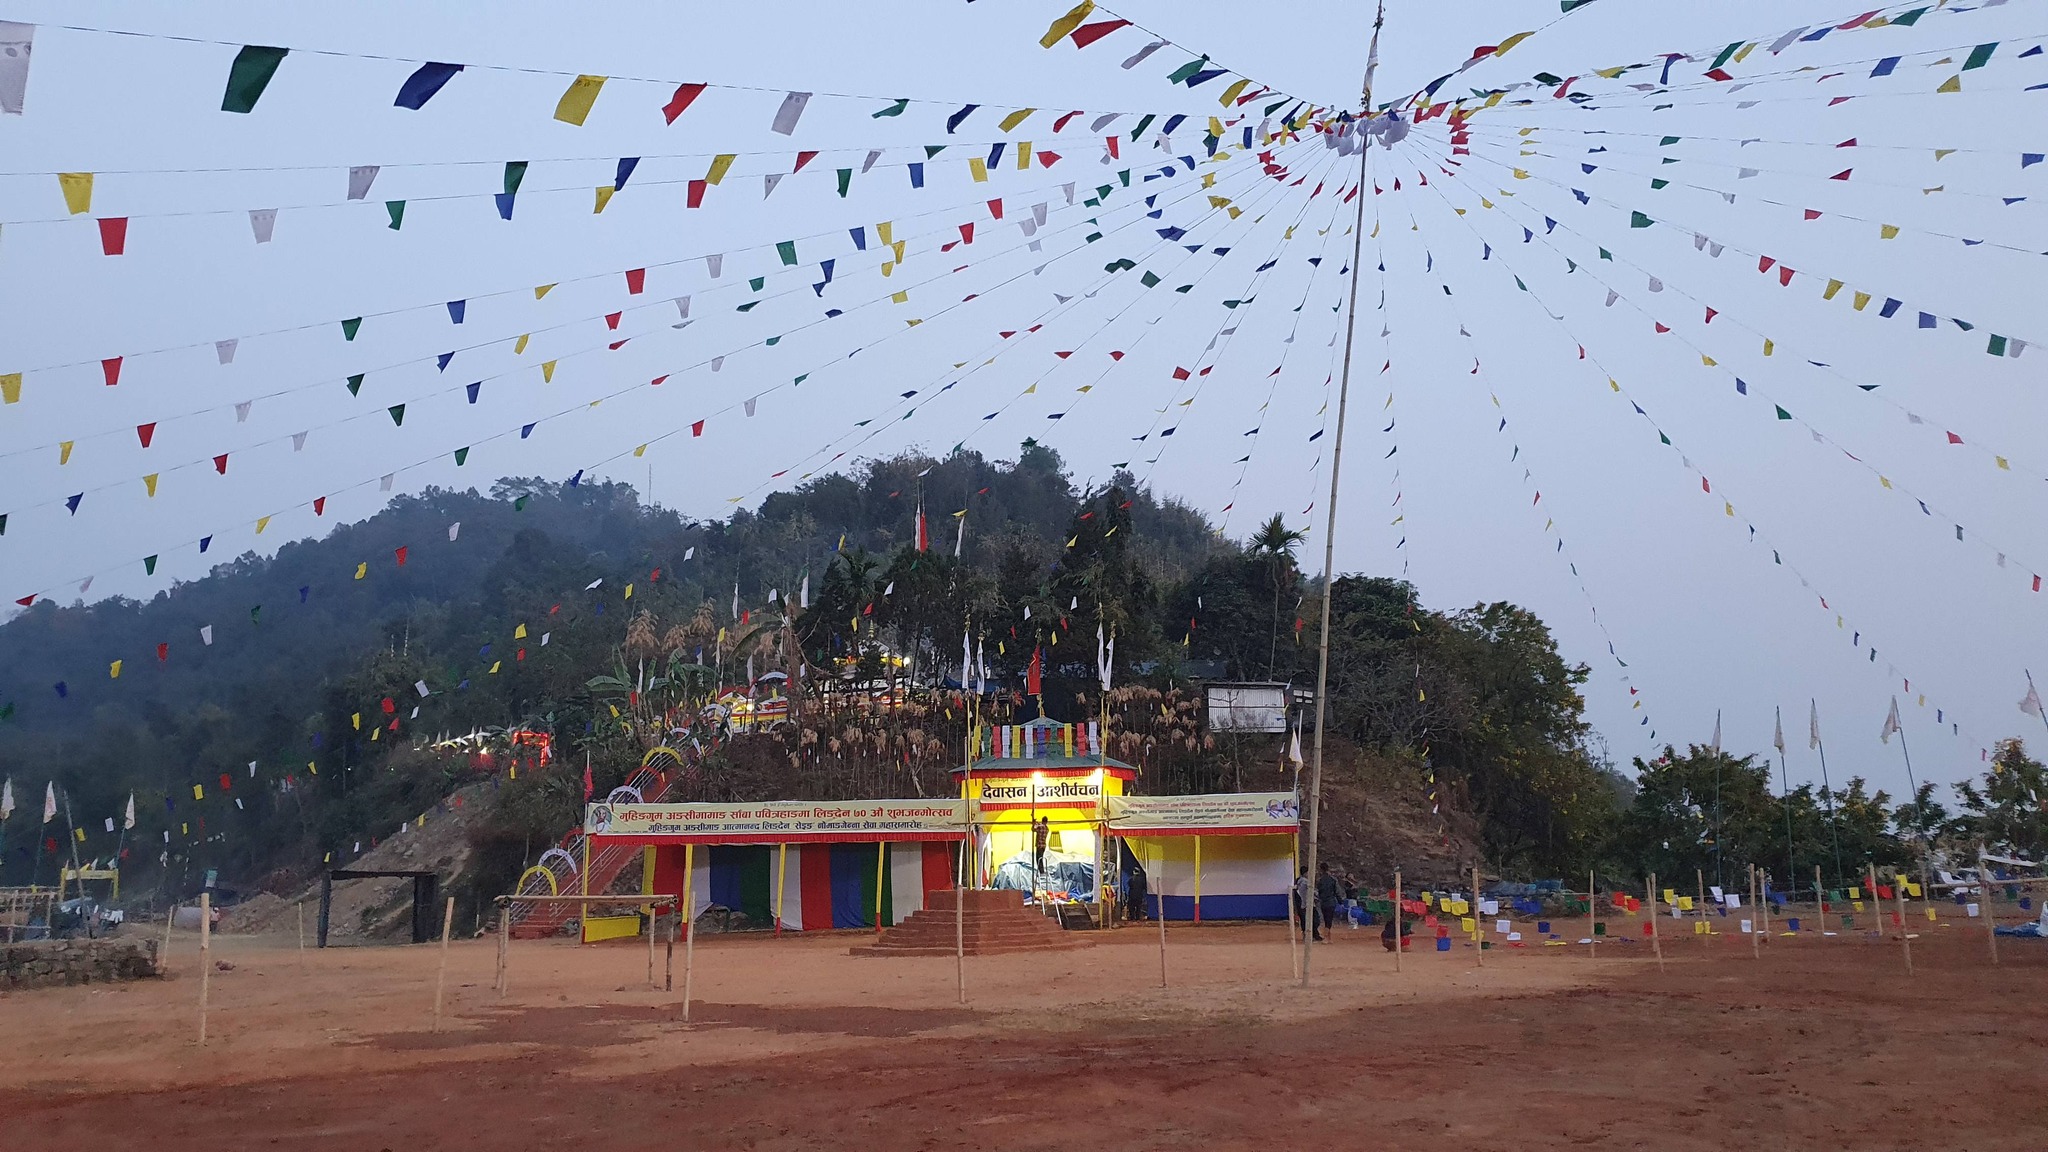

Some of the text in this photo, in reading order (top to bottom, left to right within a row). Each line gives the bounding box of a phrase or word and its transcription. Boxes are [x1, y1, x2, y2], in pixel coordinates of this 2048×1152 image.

[982, 782, 1099, 799] देवासन आशीर्वचन
[853, 809, 867, 818] ७०
[862, 819, 878, 830] सेवा
